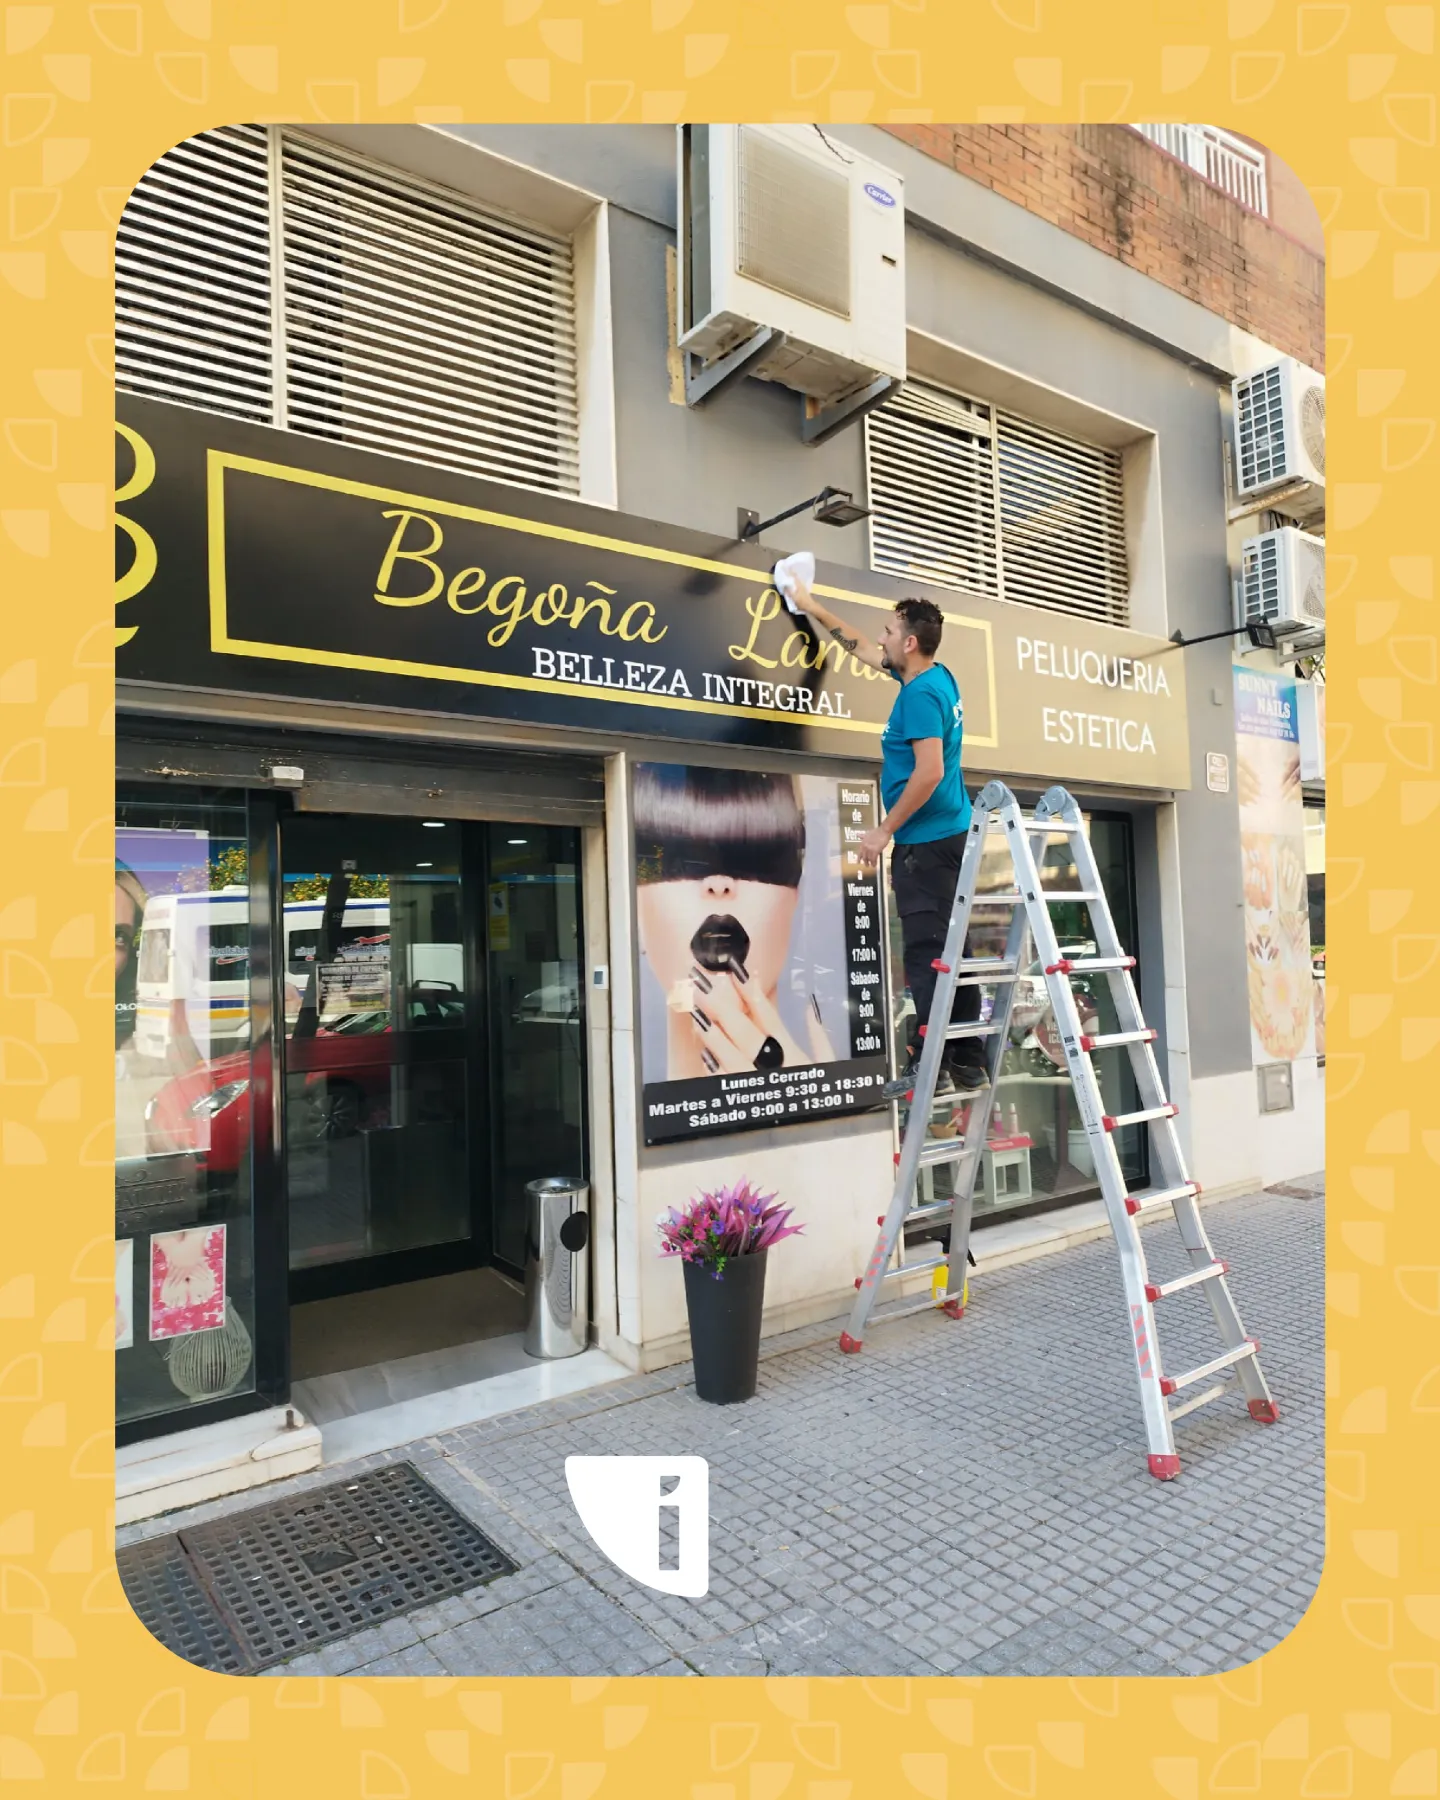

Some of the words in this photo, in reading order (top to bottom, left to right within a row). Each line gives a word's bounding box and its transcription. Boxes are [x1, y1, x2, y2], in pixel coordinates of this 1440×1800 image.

[374, 510, 668, 647] Begoña
[1016, 636, 1171, 698] PELUQUERIA
[531, 647, 692, 697] BELLEZA
[702, 672, 851, 718] INTEGRAL
[1257, 697, 1291, 719] NAILS
[1042, 706, 1156, 755] ESTETICA
[842, 788, 870, 803] Horario
[852, 808, 862, 822] de
[857, 870, 863, 880] a
[847, 883, 874, 897] Viernes
[857, 900, 866, 912] de
[854, 915, 870, 929] 9:00
[860, 935, 866, 945] a
[852, 948, 871, 962] 17:00
[871, 948, 877, 961] h
[850, 971, 880, 986] Sábados
[861, 988, 871, 1001] de
[859, 1003, 874, 1017] 9:00
[864, 1023, 871, 1033] a
[856, 1036, 875, 1051] 13:00
[875, 1036, 881, 1049] h
[721, 1076, 765, 1090] Lunes
[769, 1067, 825, 1084] Cerrado
[649, 1100, 707, 1117] Martes
[711, 1098, 721, 1108] a
[725, 1089, 782, 1106] Viernes
[785, 1084, 818, 1098] 9:30
[821, 1083, 831, 1093] a
[835, 1075, 872, 1090] 18:30
[876, 1074, 884, 1085] h
[689, 1110, 747, 1128] Sábado
[751, 1102, 785, 1118] 9:00
[788, 1103, 798, 1112] a
[802, 1094, 842, 1110] 13:00
[845, 1093, 854, 1104] h
